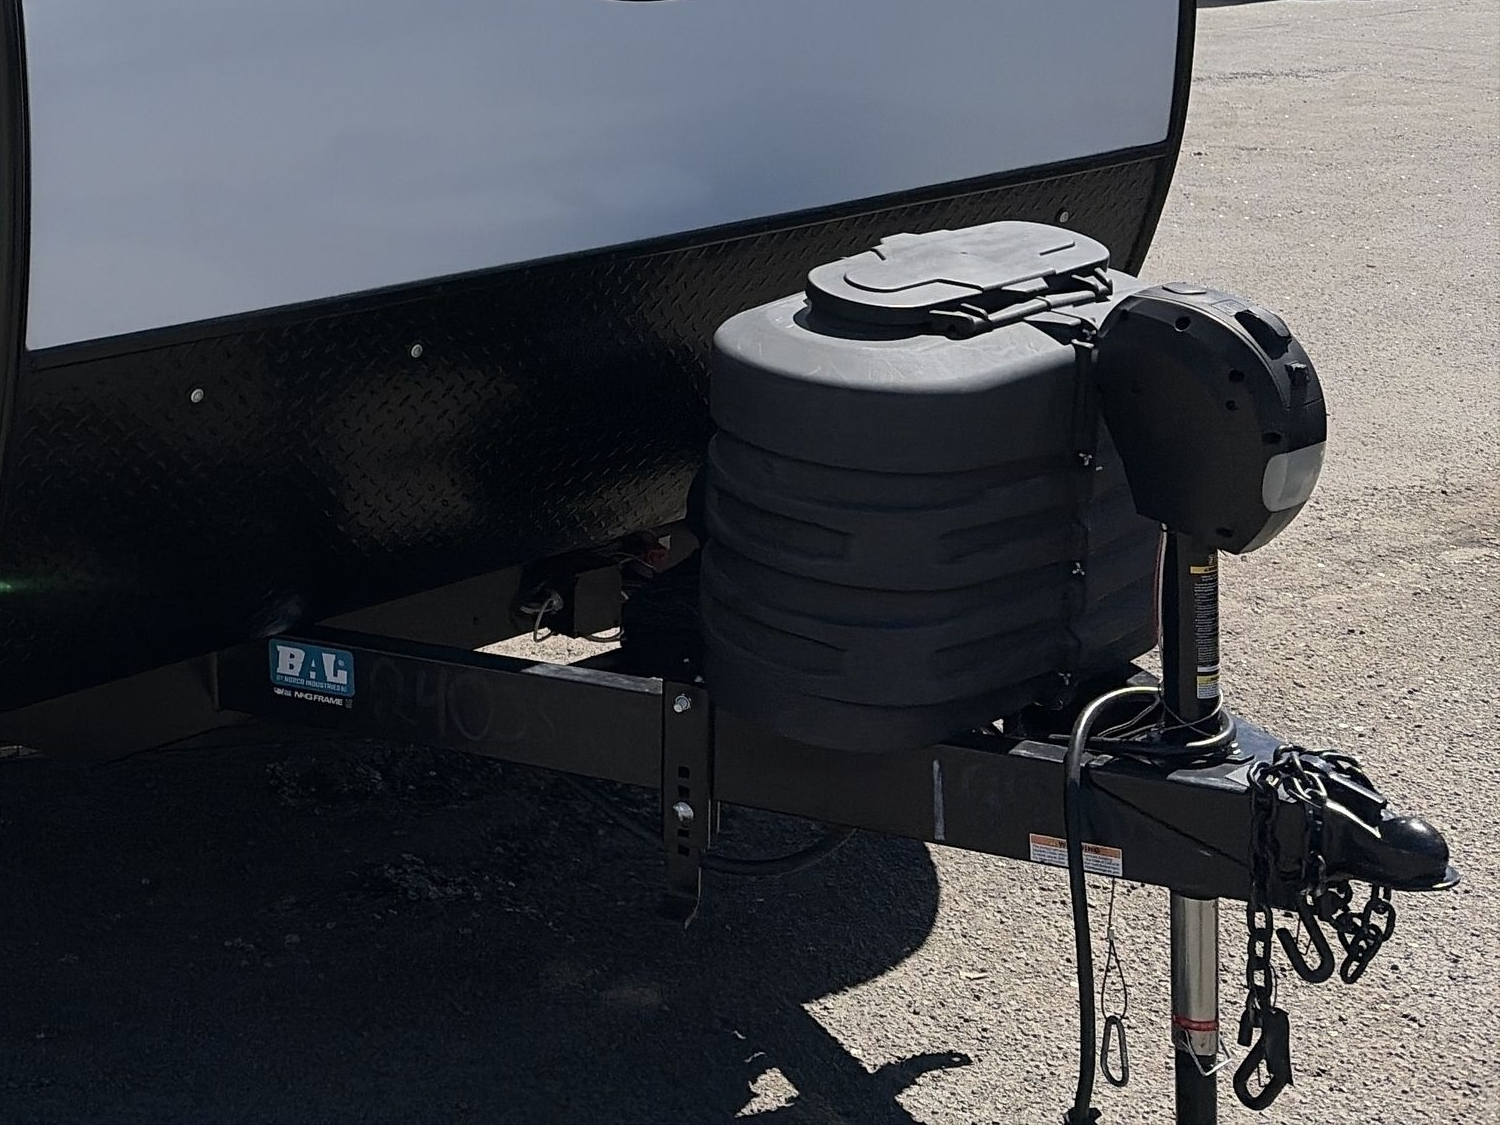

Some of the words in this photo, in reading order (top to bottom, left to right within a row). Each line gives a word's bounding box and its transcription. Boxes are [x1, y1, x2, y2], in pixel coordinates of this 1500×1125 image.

[276, 644, 348, 685] BAL
[284, 677, 305, 686] NORCO
[305, 679, 340, 691] INDUSTRIES
[313, 694, 343, 706] FRAME
